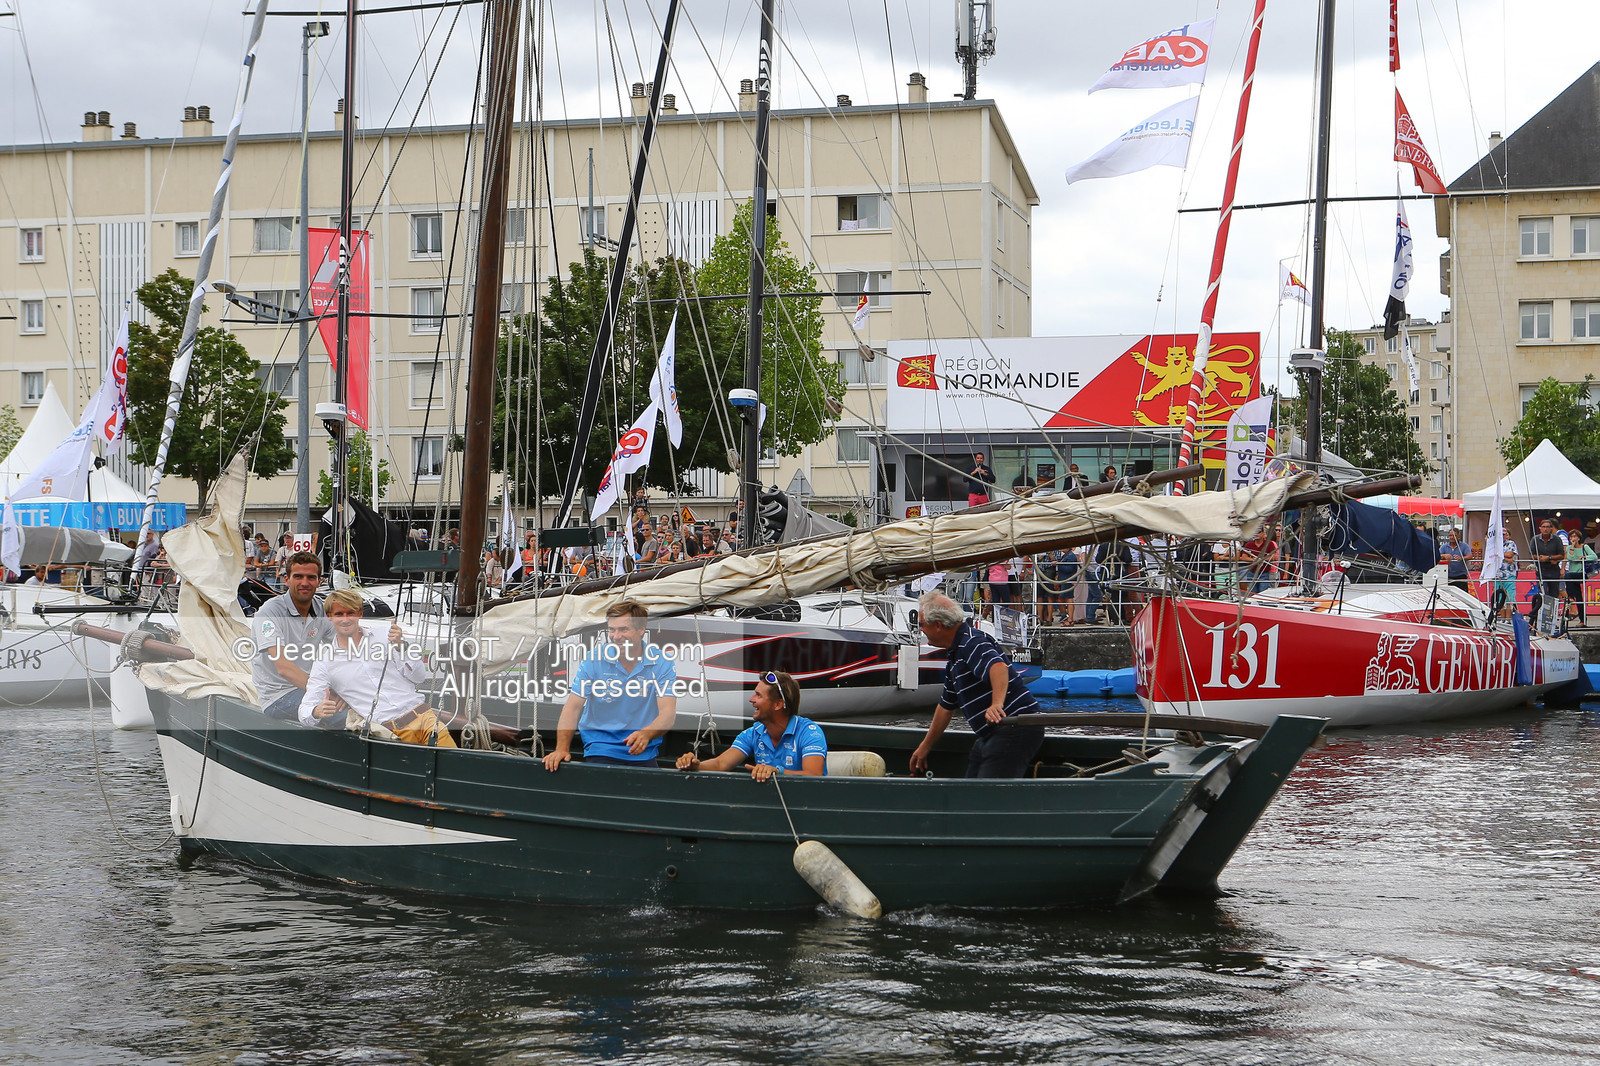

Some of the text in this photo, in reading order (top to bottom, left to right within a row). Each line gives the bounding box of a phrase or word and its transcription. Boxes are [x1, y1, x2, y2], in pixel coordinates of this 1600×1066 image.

[945, 356, 1011, 371] RÉGION
[945, 372, 1080, 390] NORMANDIE
[293, 540, 311, 552] 69
[0, 648, 42, 670] RYS
[1202, 621, 1281, 690] 131
